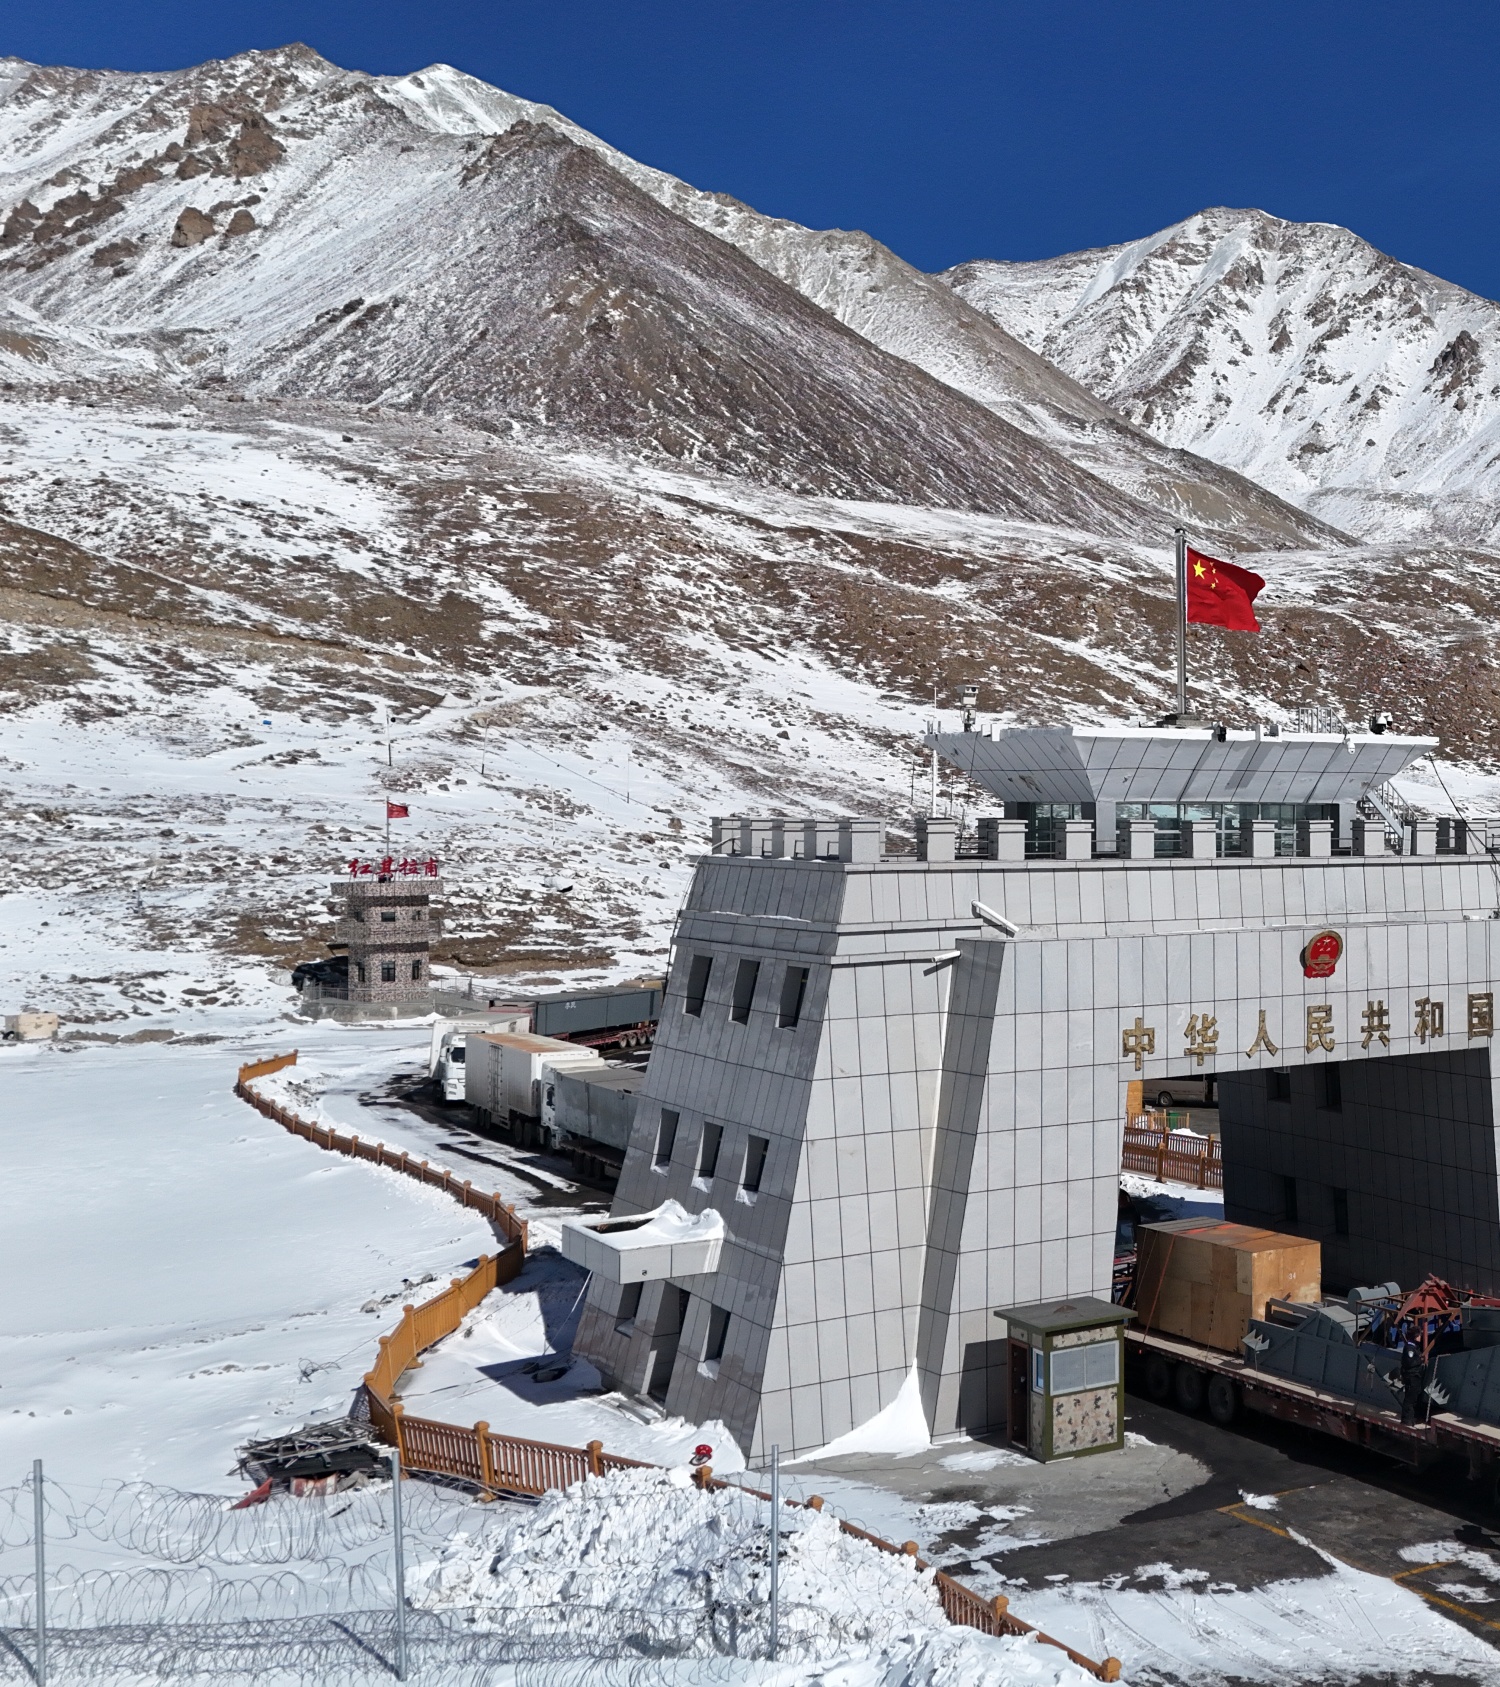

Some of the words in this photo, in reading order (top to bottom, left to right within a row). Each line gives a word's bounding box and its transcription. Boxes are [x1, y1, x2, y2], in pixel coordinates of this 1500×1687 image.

[348, 856, 439, 878] 红其拉甫
[1123, 992, 1493, 1071] 中华人民共和国
